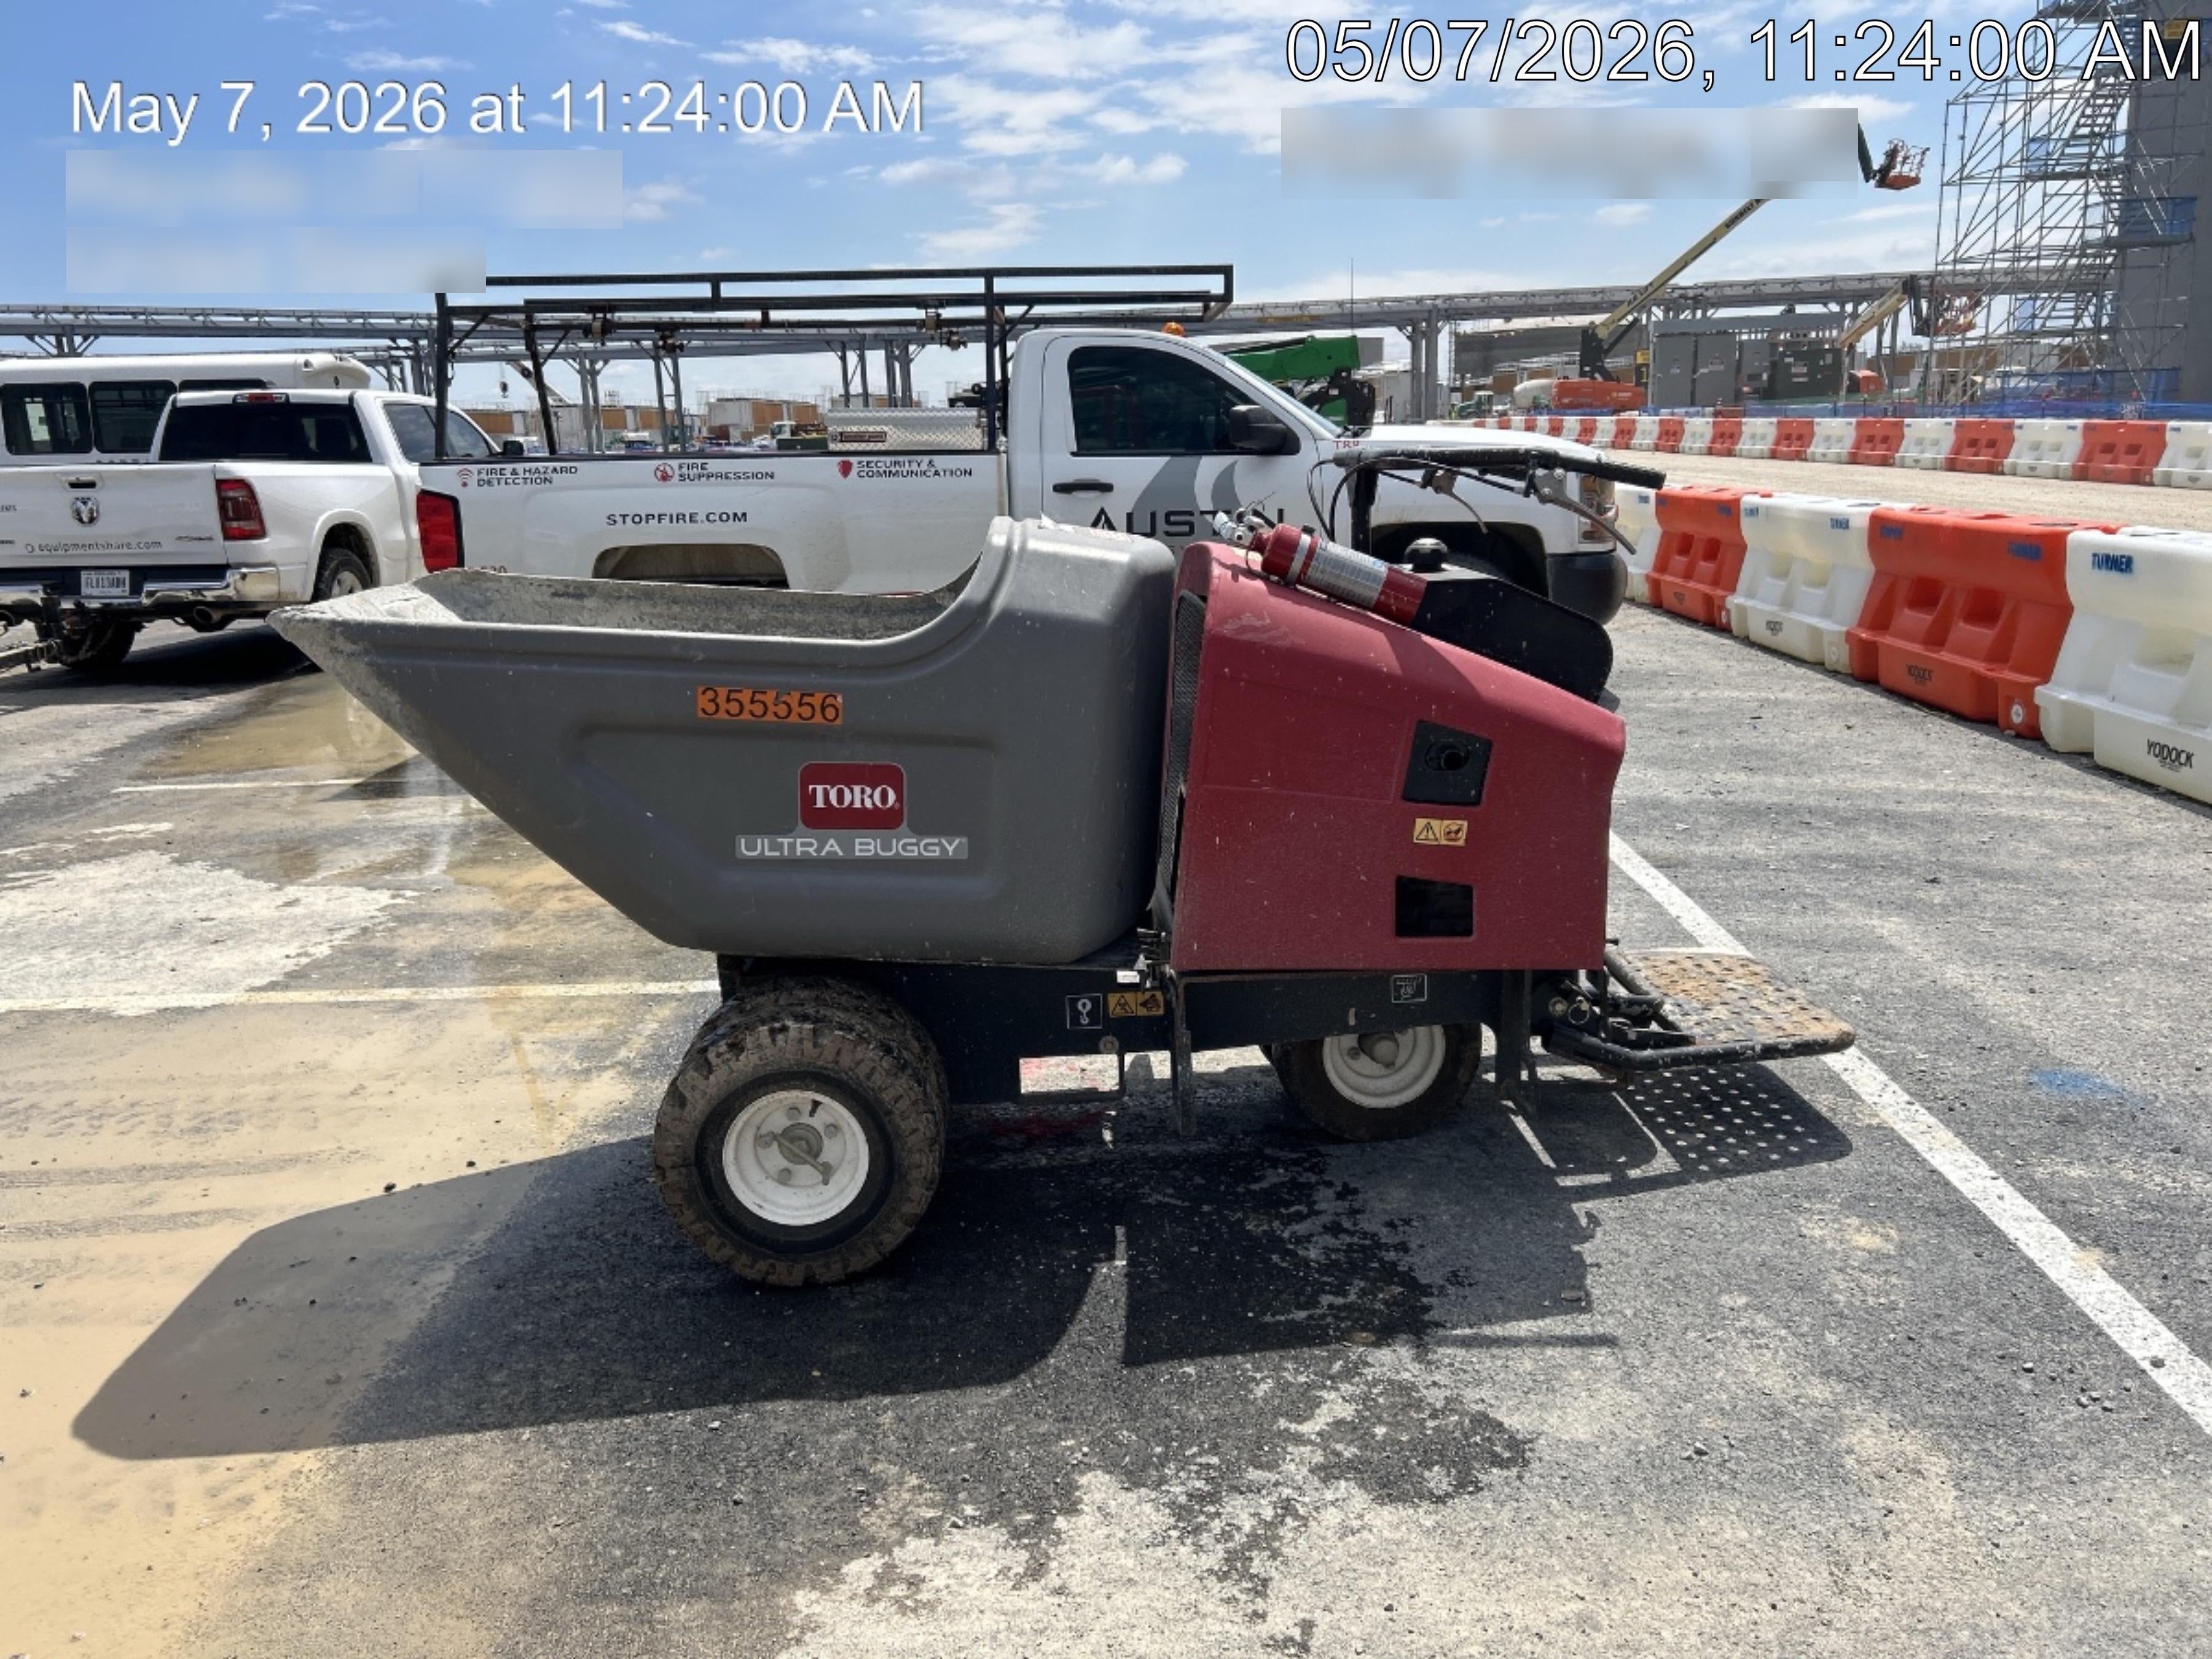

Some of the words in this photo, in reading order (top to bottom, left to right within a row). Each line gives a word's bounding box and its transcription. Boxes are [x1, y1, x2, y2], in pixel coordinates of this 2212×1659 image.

[678, 462, 709, 471] FIRE
[857, 460, 925, 469] SECURITY
[927, 459, 936, 469] &
[477, 468, 507, 477] FIRE
[510, 467, 519, 476] &
[523, 466, 578, 475] HAZARD
[678, 471, 775, 482] SUPPRESSION
[857, 468, 973, 478] COMMUNICATION
[477, 476, 553, 487] DETECTION
[606, 512, 748, 525] STOPFIRE.COM
[38, 541, 162, 554] equipmentshare.com
[2091, 552, 2134, 574] TURNER
[700, 686, 840, 723] 355556
[2147, 738, 2195, 769] YODOCK
[809, 785, 897, 809] TORO
[740, 837, 844, 856] ULTRA
[854, 837, 961, 856] BUGGY
